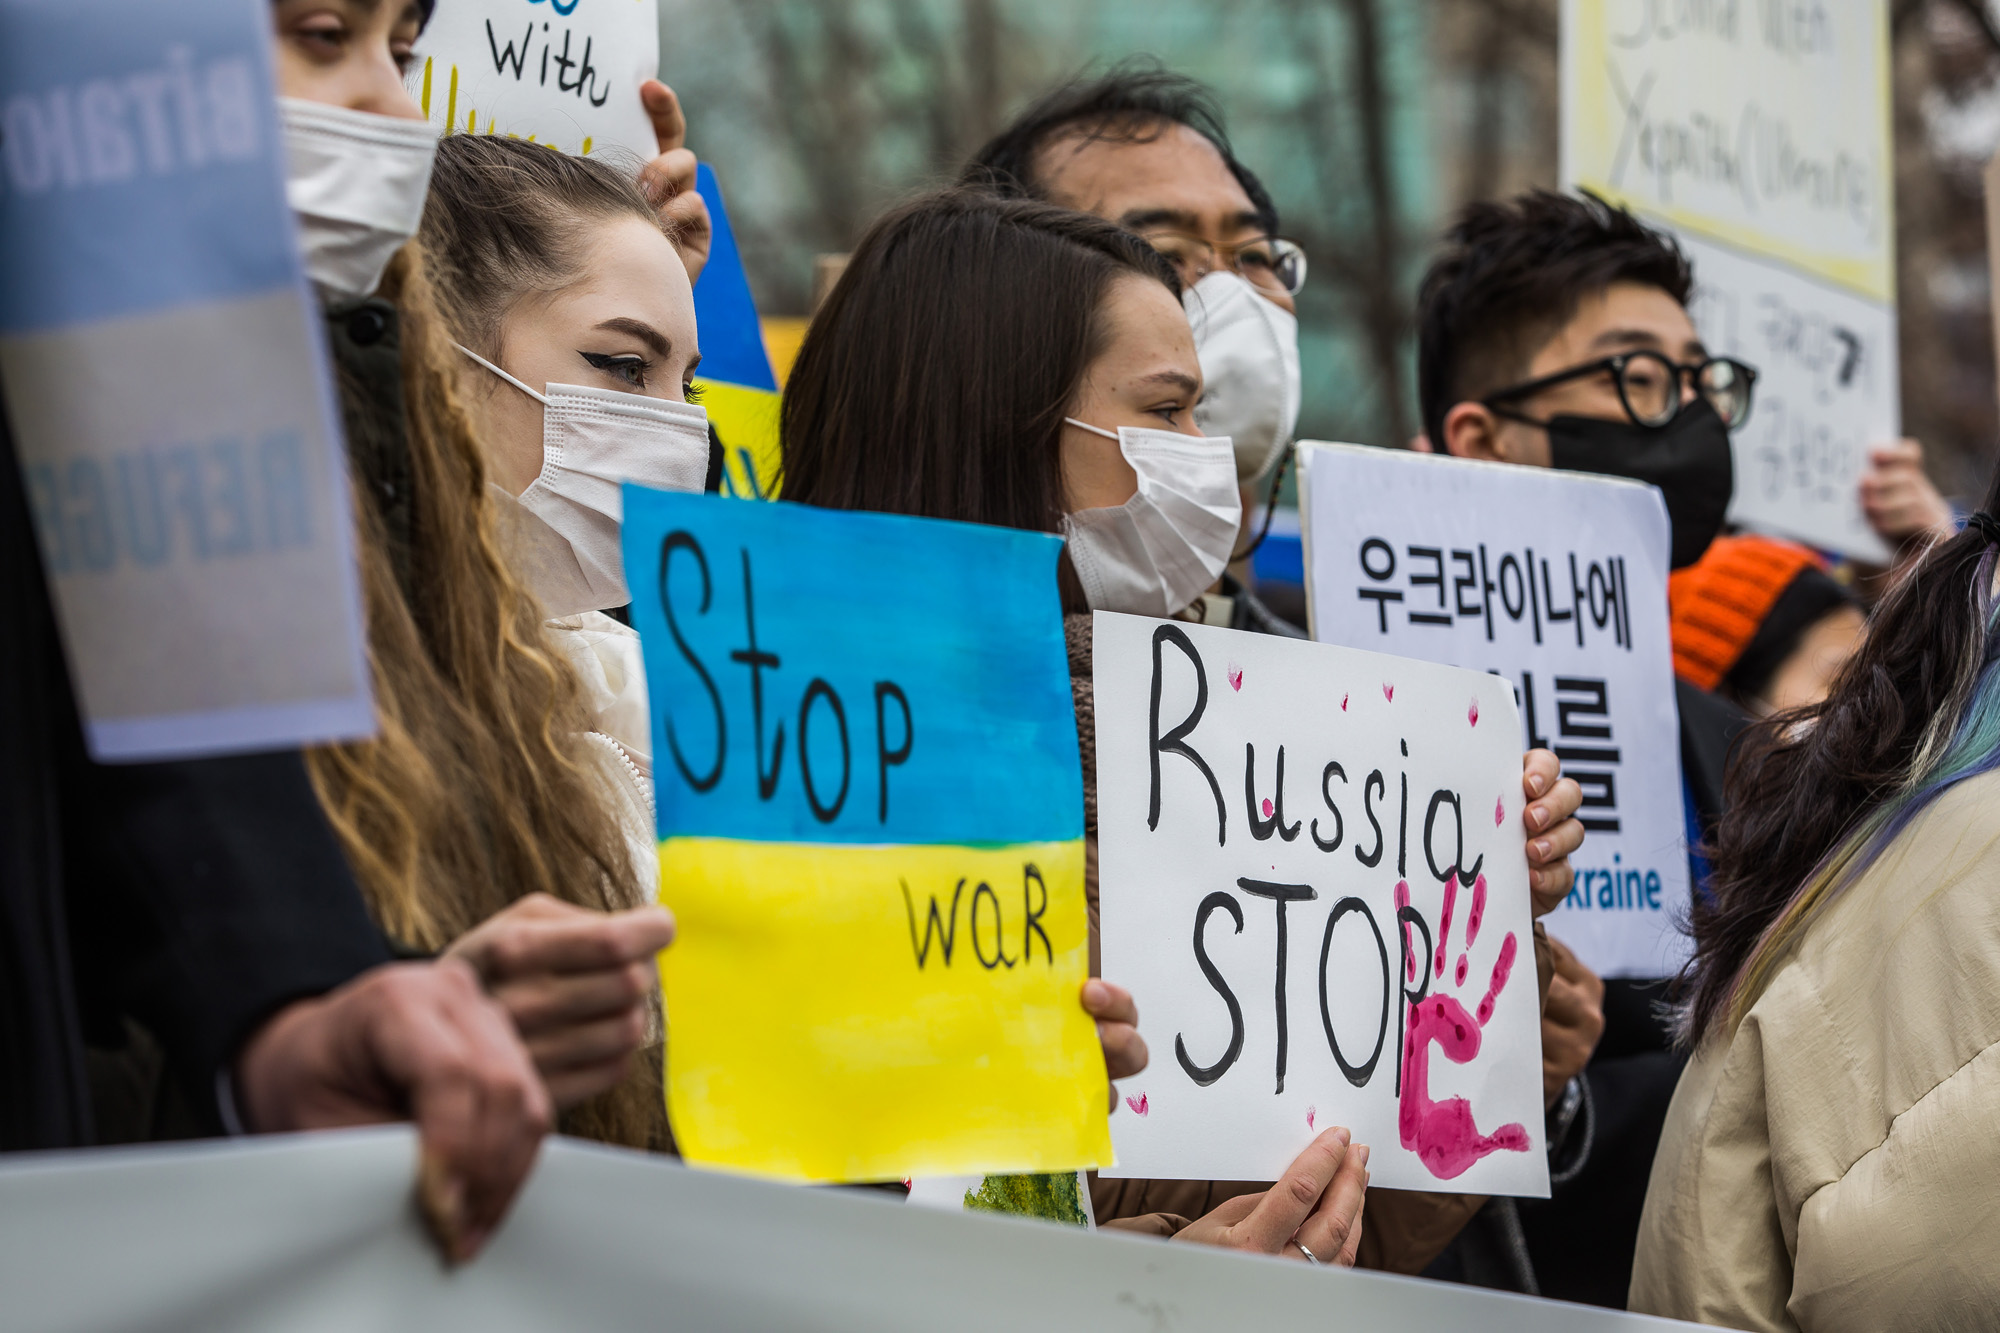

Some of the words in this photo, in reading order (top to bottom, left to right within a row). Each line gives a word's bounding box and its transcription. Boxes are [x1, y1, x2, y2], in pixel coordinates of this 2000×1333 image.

[485, 18, 611, 108] With
[1357, 536, 1632, 650] 우크라이나에
[1147, 623, 1484, 888] Russia
[1566, 852, 1662, 910] kraine
[1175, 877, 1432, 1097] STOP
